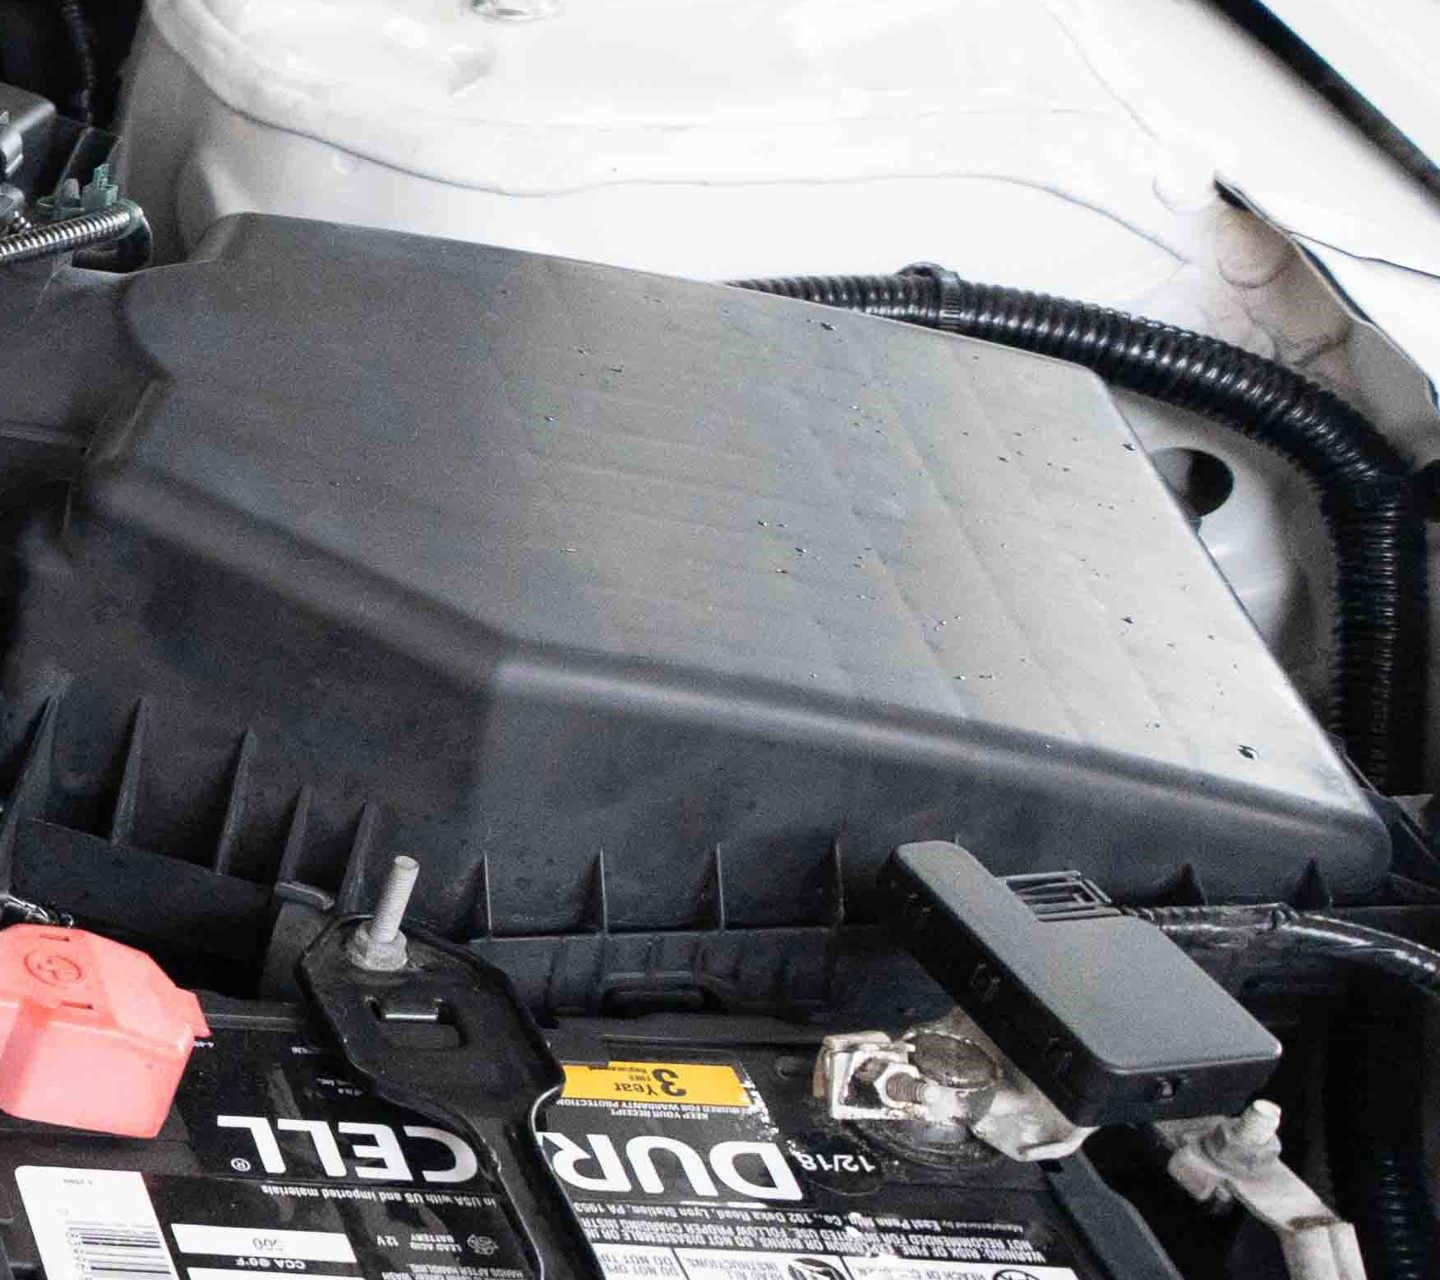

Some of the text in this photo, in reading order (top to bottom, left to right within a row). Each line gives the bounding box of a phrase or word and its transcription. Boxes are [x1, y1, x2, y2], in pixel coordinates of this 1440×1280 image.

[613, 1068, 688, 1098] 3 Year
[321, 1186, 377, 1202] imported
[378, 1191, 402, 1203] and
[404, 1192, 425, 1204] US
[275, 1257, 307, 1271] CCA
